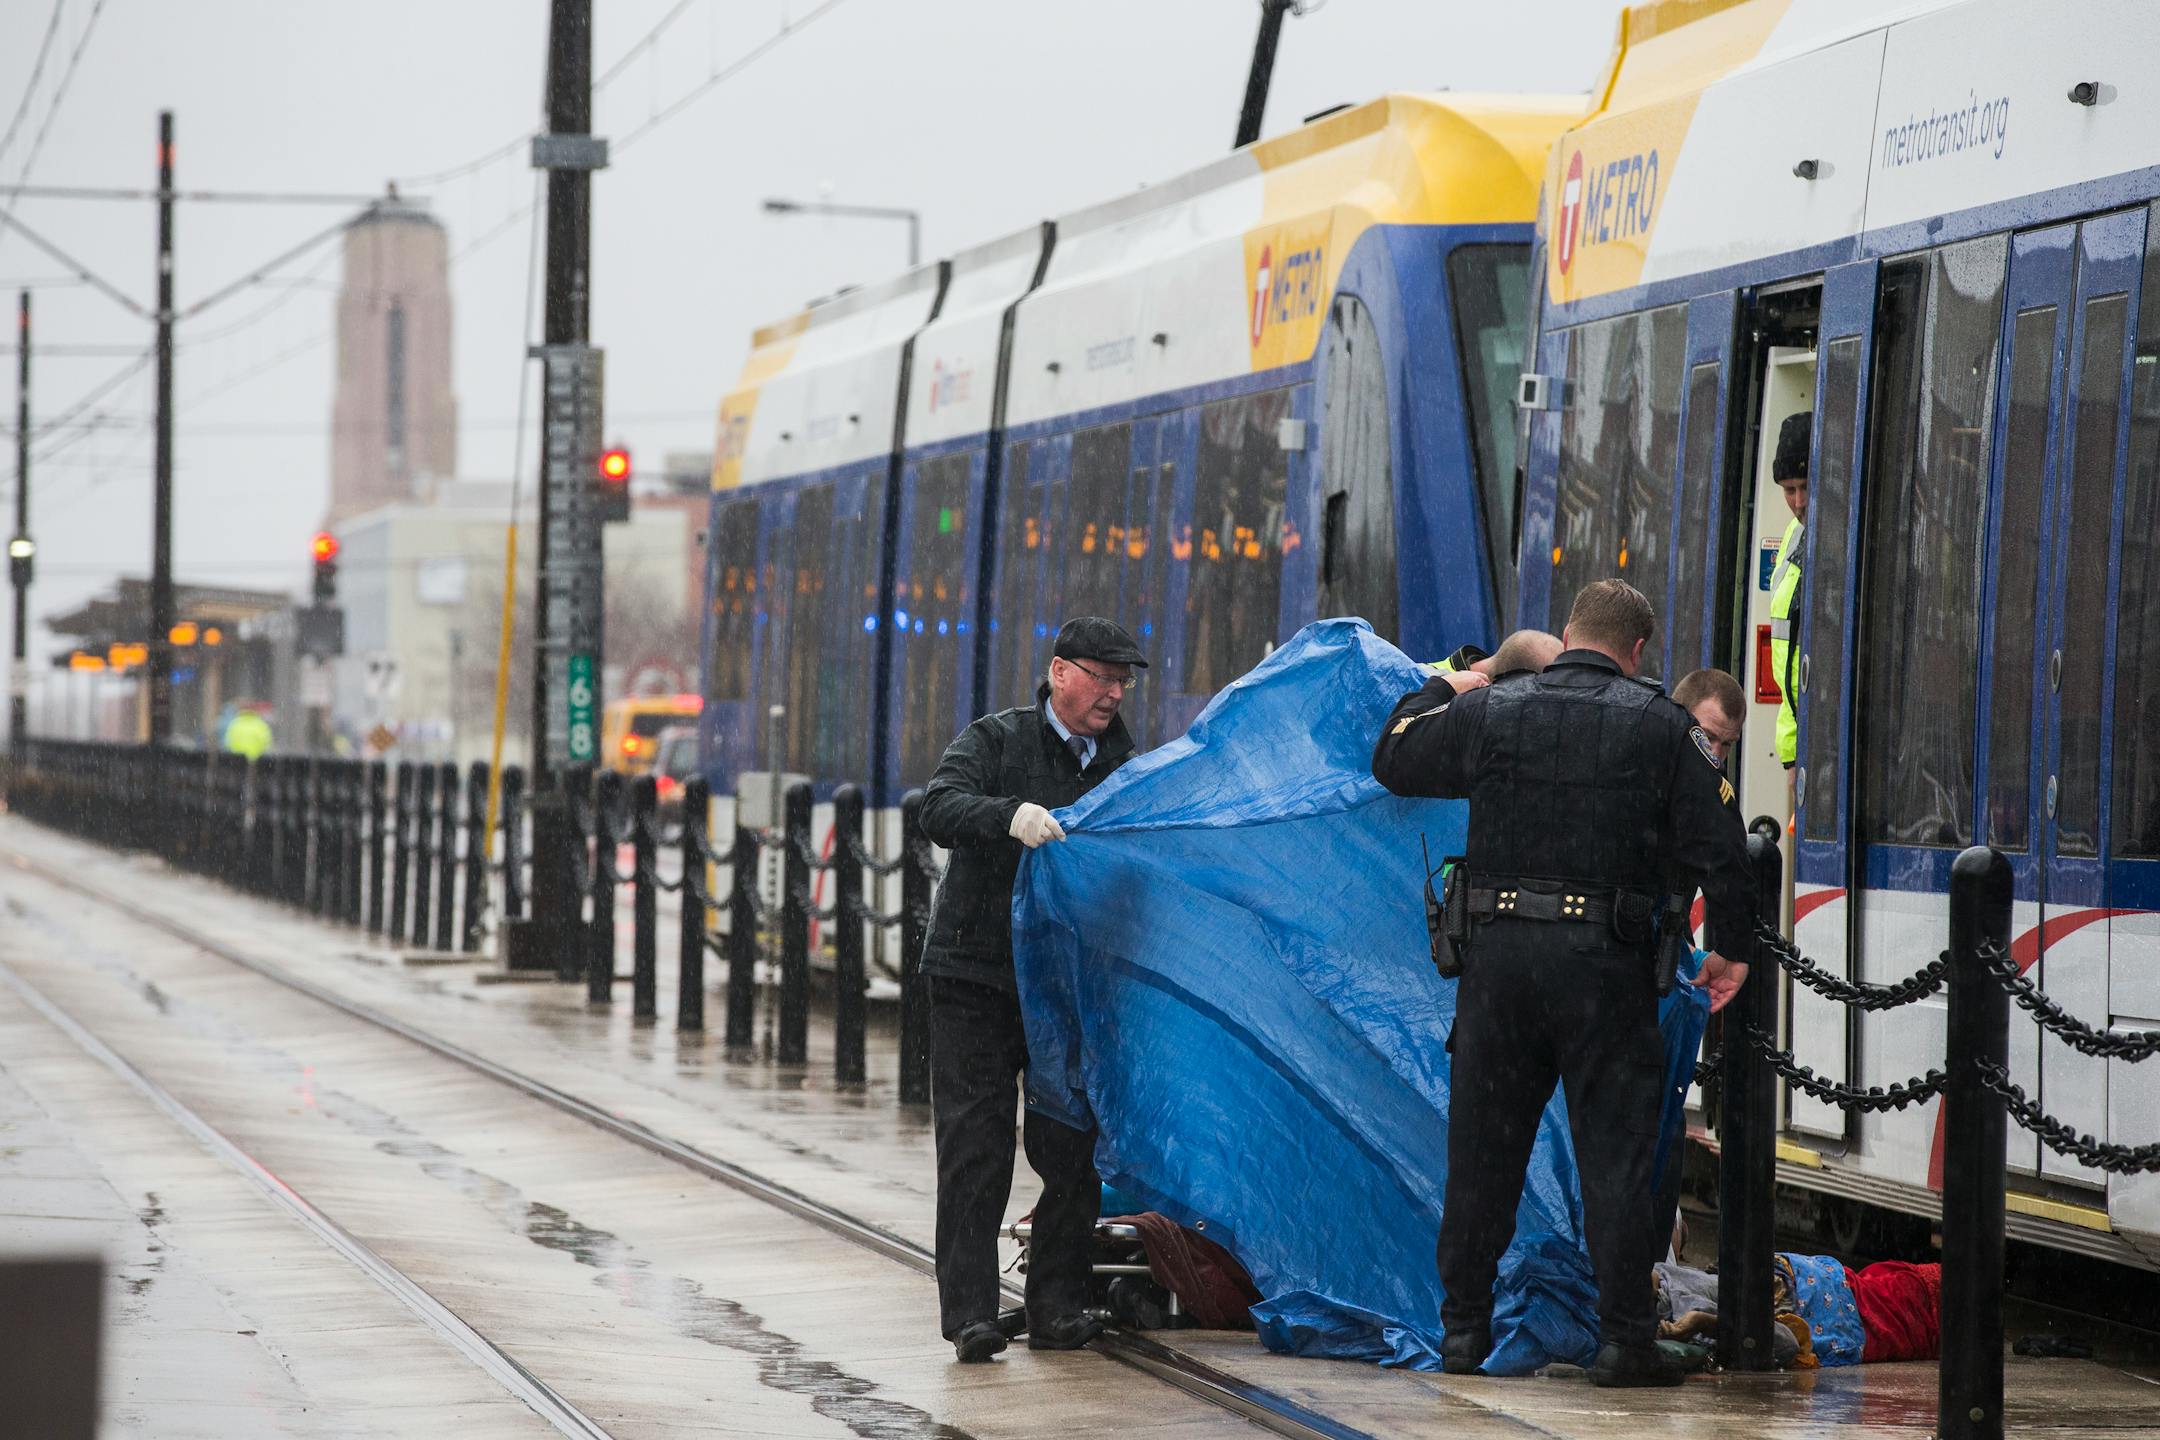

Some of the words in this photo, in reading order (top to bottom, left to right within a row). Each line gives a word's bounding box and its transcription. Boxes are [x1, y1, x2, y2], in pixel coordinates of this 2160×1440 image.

[1882, 87, 2009, 168] metrotransit.org
[1581, 148, 1659, 248] METRO
[1269, 246, 1322, 325] METRO
